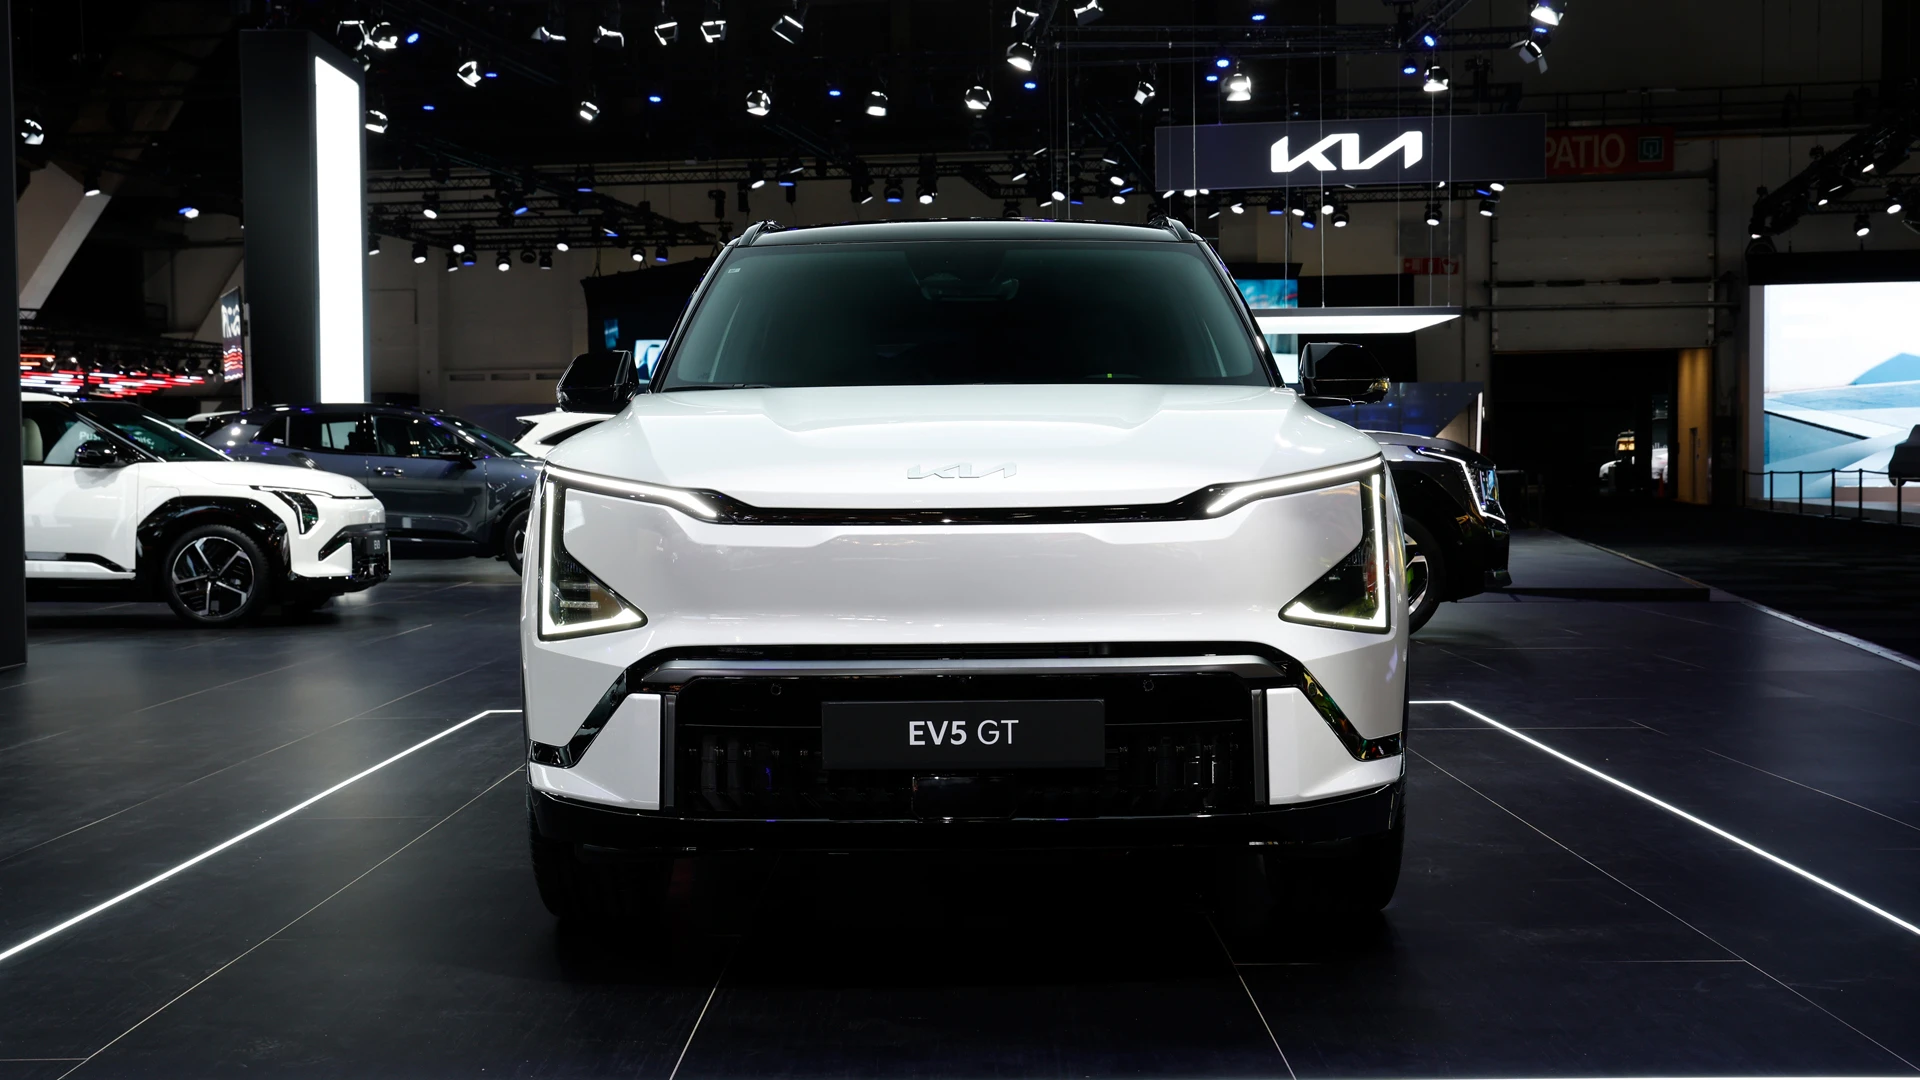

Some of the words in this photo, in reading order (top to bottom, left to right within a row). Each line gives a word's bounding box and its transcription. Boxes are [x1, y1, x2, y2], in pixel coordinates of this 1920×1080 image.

[1271, 131, 1422, 172] KIA
[1545, 132, 1626, 169] PATIO
[907, 462, 1017, 480] KIA
[909, 721, 966, 745] EV5
[977, 720, 1019, 745] GT
